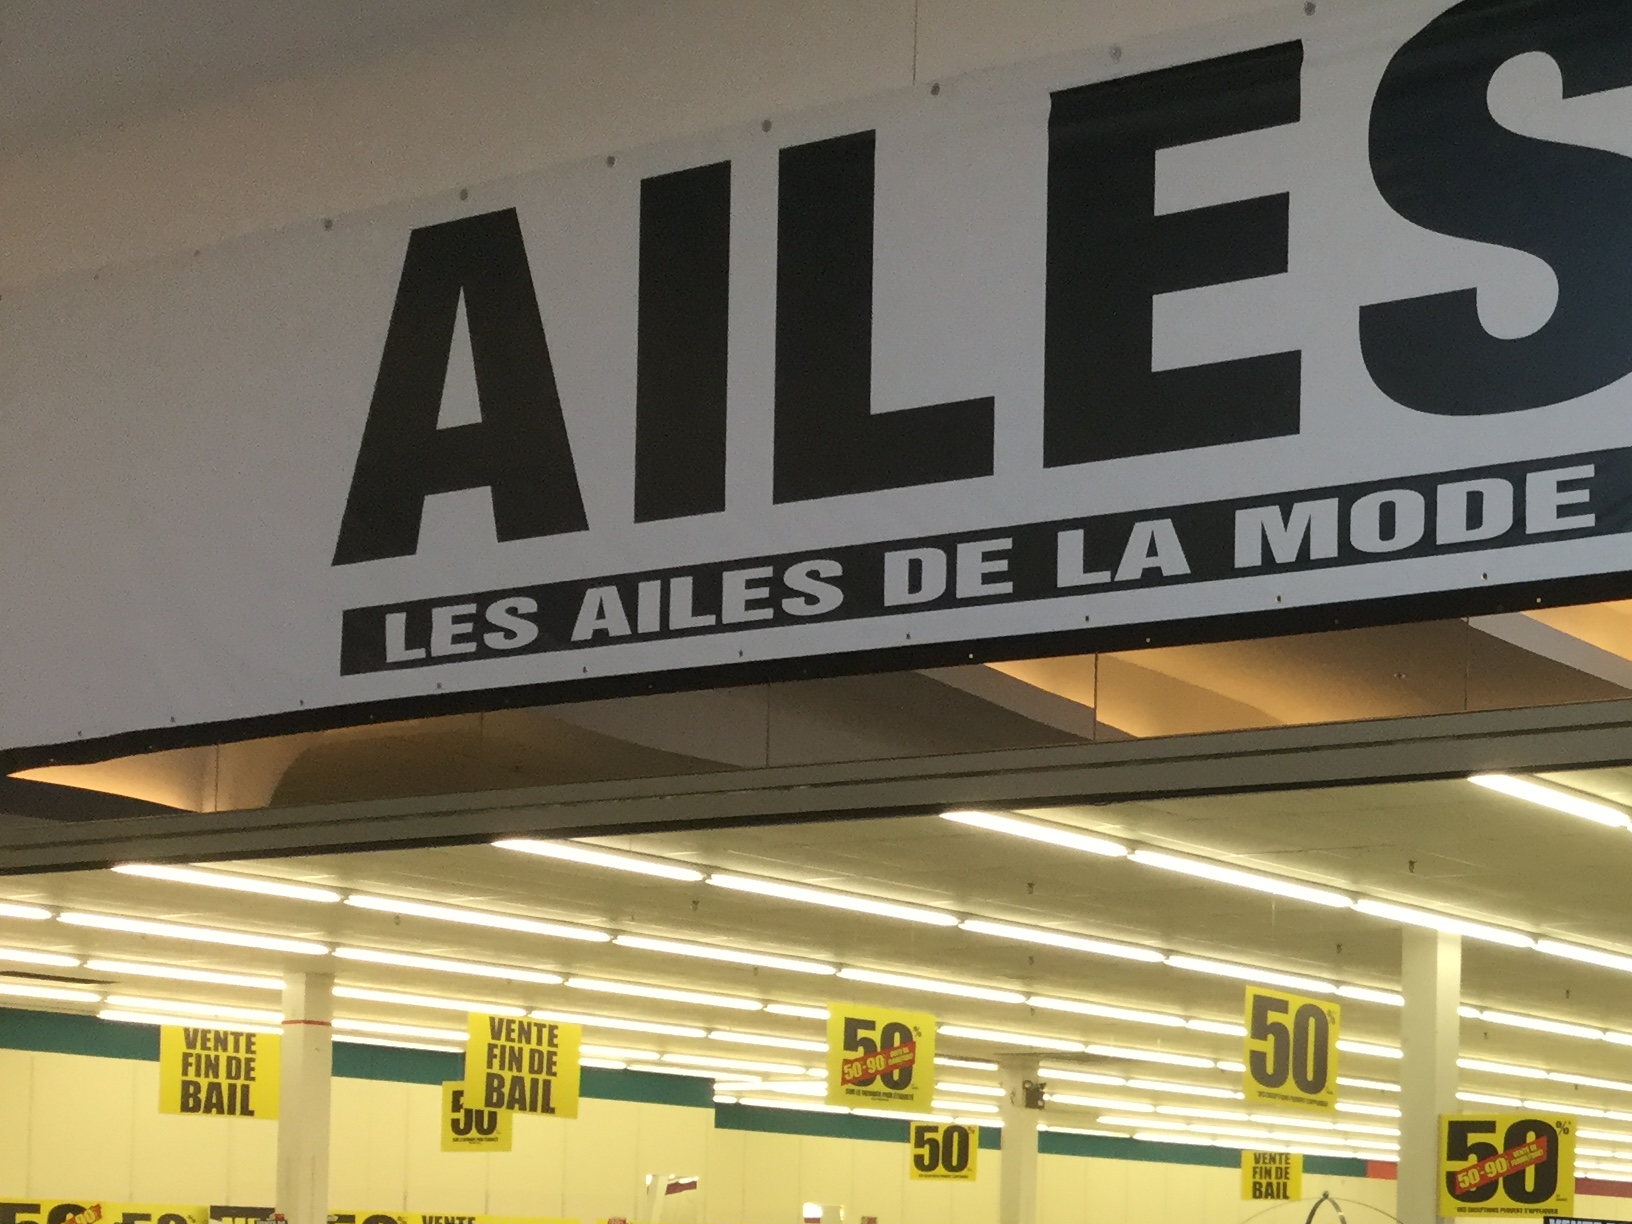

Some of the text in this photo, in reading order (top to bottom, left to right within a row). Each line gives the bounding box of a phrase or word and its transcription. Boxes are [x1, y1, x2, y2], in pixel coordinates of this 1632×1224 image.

[385, 463, 1596, 663] LES AILES DE LA MODE
[184, 1027, 257, 1055] VENTE
[489, 1016, 559, 1049] VENTE
[181, 1051, 256, 1082] FIN DE
[486, 1043, 558, 1077] FIN DE
[180, 1080, 255, 1117] BAIL
[484, 1072, 556, 1115] BAIL
[1252, 1166, 1290, 1181] FIN DE
[1253, 1152, 1291, 1165] VENTE
[1252, 1182, 1290, 1200] BAIL
